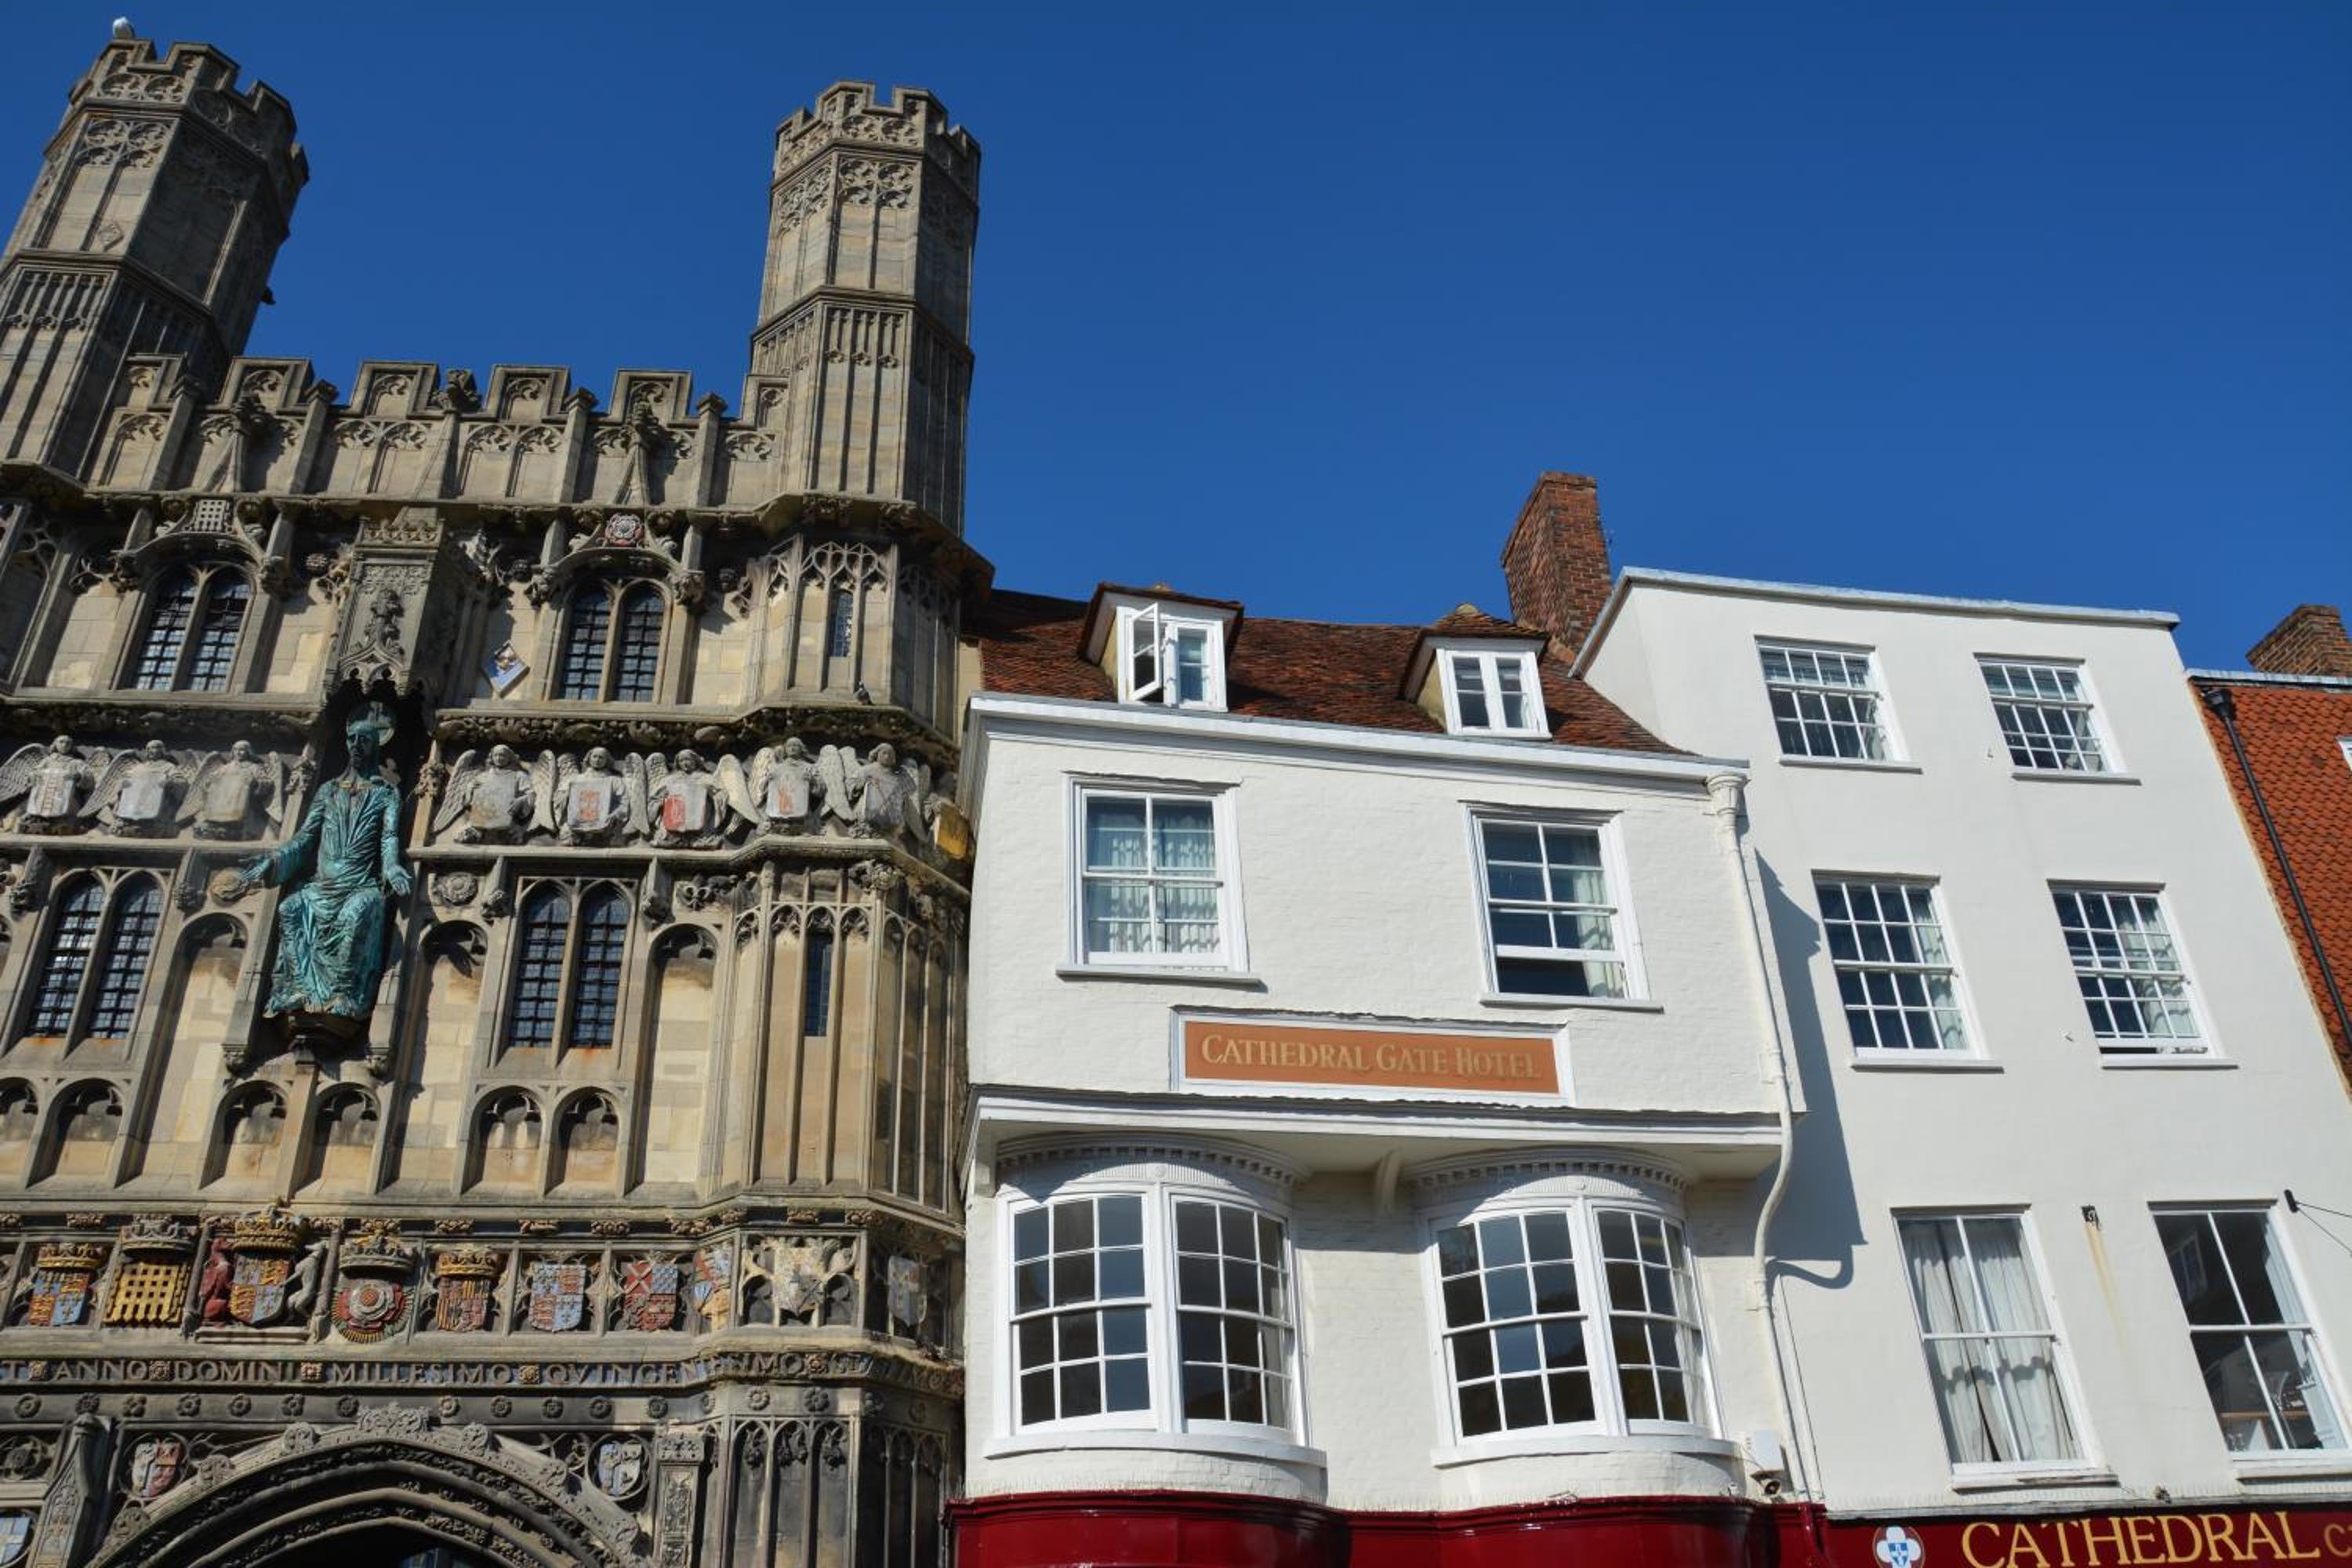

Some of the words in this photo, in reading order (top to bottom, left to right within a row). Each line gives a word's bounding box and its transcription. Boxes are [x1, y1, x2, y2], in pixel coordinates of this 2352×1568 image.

[1201, 1033, 1372, 1072] CATHEDRAL
[1376, 1044, 1449, 1075] GATE
[1455, 1046, 1543, 1080] HOTEL
[50, 1359, 147, 1381] ANNO
[175, 1360, 296, 1381] DOMINI
[332, 1362, 511, 1384] MILLESIMO
[1962, 1511, 2321, 1568] CATHEDRAL
